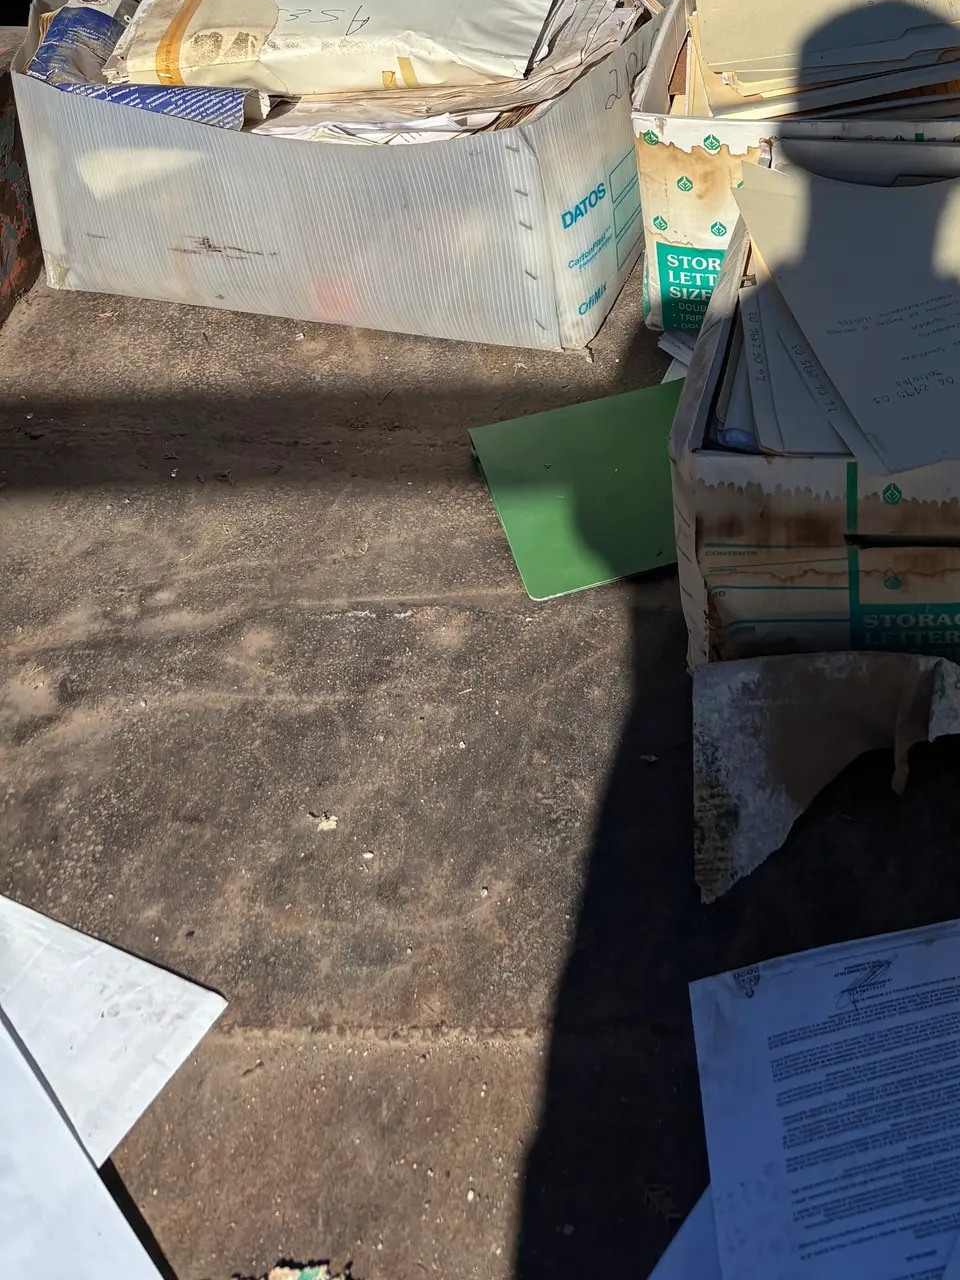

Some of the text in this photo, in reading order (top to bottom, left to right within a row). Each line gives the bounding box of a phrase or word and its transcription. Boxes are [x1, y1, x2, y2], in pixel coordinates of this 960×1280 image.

[561, 182, 607, 230] DATOS
[667, 253, 721, 271] STOR
[667, 270, 718, 287] LETT
[578, 282, 608, 317] OfiMix
[863, 629, 960, 647] LETTER
